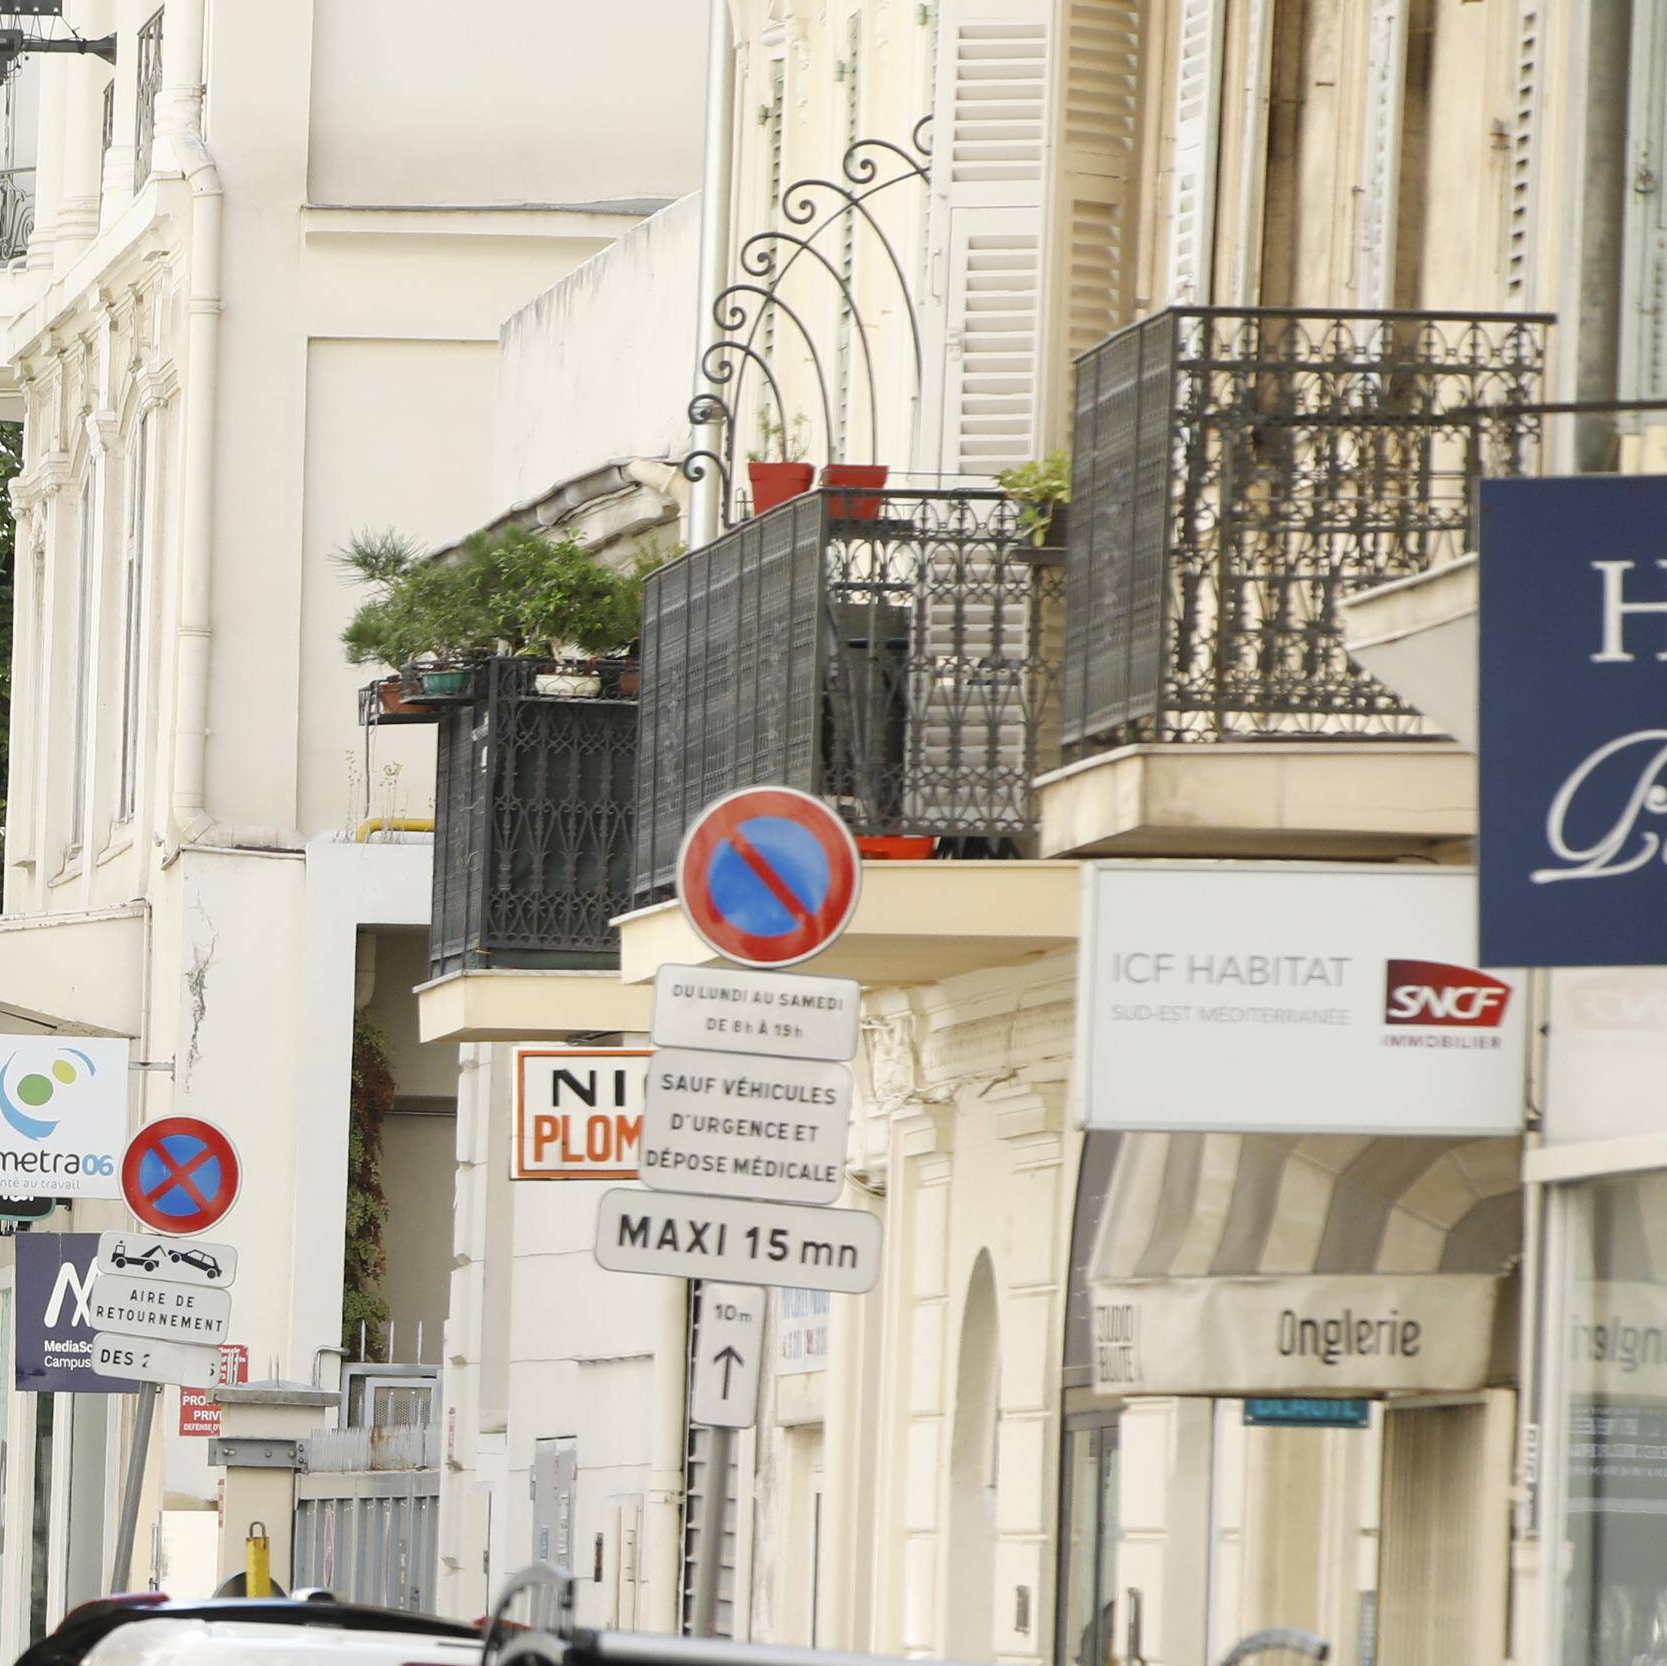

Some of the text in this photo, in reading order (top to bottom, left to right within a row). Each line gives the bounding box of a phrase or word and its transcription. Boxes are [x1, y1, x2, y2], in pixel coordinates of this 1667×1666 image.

[1111, 951, 1354, 987] ICF HABITAT
[672, 984, 843, 1011] DU LUNDI AU SAMEDI
[1387, 985, 1505, 1019] SNCF
[706, 1017, 726, 1032] DE
[1111, 1004, 1194, 1024] SUD-EST
[1381, 1034, 1503, 1050] IMMOBILIER
[552, 1069, 648, 1107] NI
[661, 1073, 838, 1106] SAUF VÉHICULES
[671, 1112, 820, 1142] D'URGENCE ET
[646, 1147, 838, 1184] DÉPOSE MÉDICALE
[23, 1180, 37, 1189] au
[41, 1180, 81, 1190] travail
[618, 1214, 859, 1270] MAXI 15 mn
[130, 1289, 195, 1308] AIRE DE
[96, 1305, 223, 1333] RETOURNEMENT
[1278, 1309, 1421, 1366] Onglerie
[44, 1355, 91, 1371] Campus
[100, 1349, 134, 1366] DES
[194, 1410, 221, 1421] PRIV
